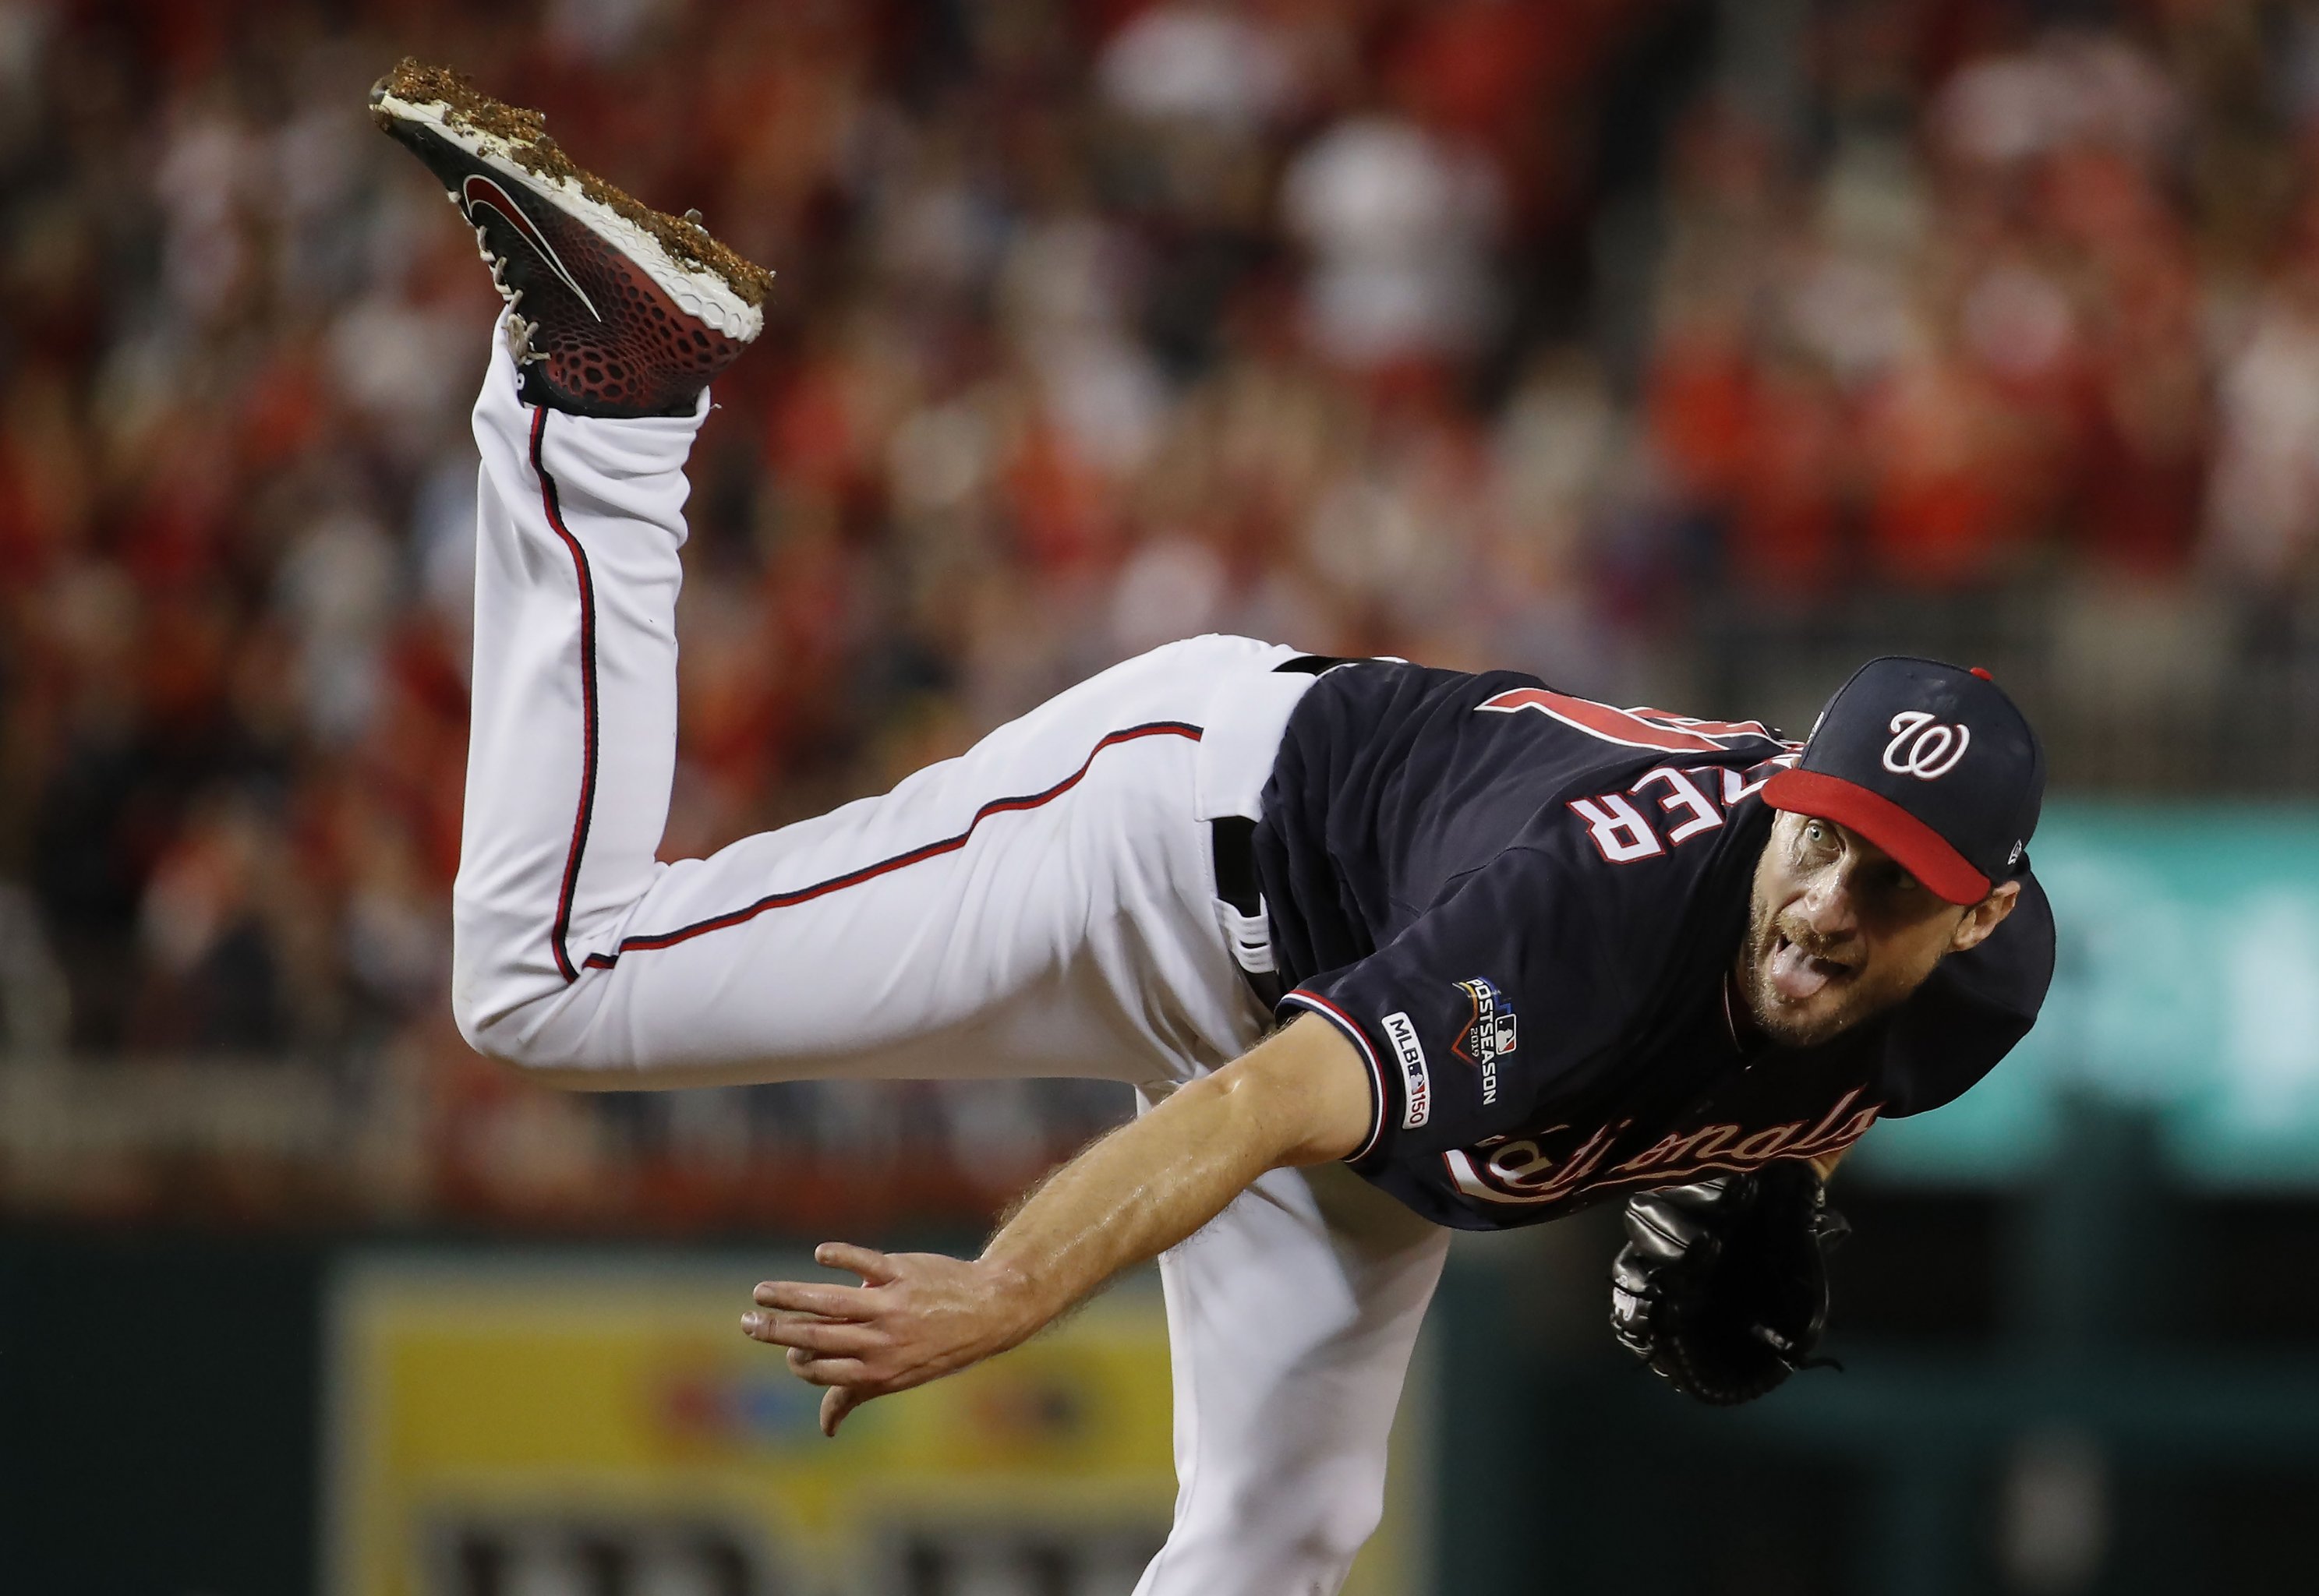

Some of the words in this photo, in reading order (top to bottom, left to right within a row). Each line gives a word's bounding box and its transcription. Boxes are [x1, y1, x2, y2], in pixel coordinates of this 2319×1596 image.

[1882, 710, 1971, 780] W
[1390, 1019, 1419, 1065] MLB
[1409, 1093, 1426, 1125] 150
[1466, 978, 1497, 1106] POSTSEASON
[1470, 1027, 1479, 1058] 2019
